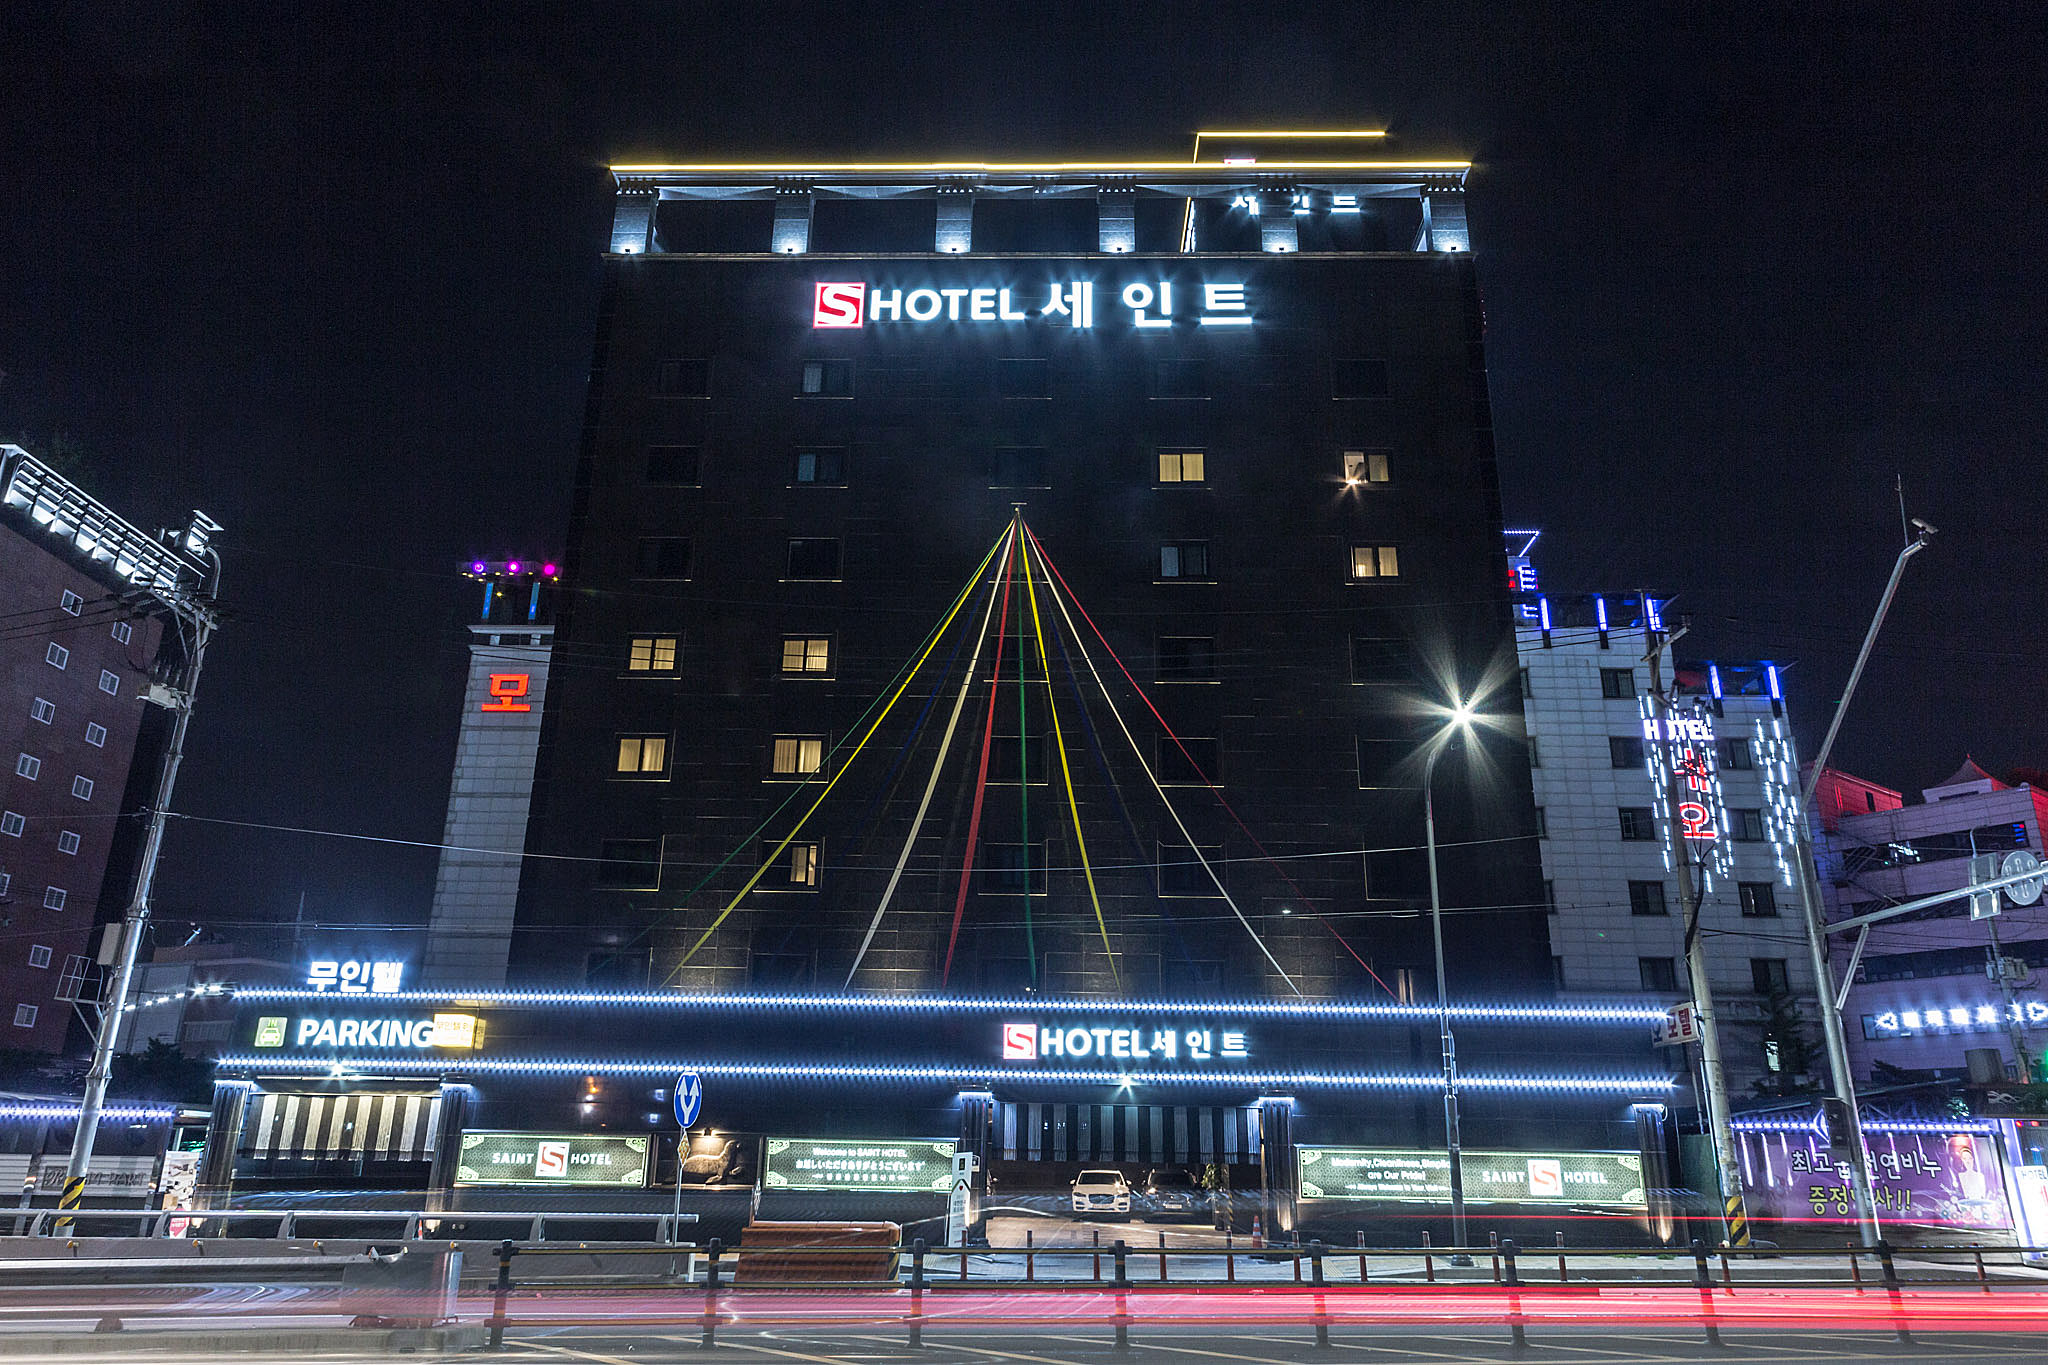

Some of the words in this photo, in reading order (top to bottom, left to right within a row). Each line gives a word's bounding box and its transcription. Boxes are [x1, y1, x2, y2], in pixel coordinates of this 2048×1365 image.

[868, 286, 1026, 322] HOTEL
[481, 673, 531, 712] 모
[306, 961, 403, 993] 무인텔
[297, 1019, 434, 1047] PARKING
[1040, 1028, 1150, 1057] HOTEL
[491, 1152, 535, 1164] SAINT
[570, 1153, 613, 1165] HOTEL
[812, 1147, 847, 1157] Welcome
[848, 1148, 856, 1157] to
[857, 1148, 880, 1157] SAINT
[881, 1149, 907, 1158] HOTEL
[1367, 1171, 1382, 1179] are
[1383, 1171, 1399, 1180] Our
[1482, 1170, 1525, 1183] SAINT
[1564, 1171, 1608, 1184] HOTEL
[1808, 1185, 1912, 1215] 증정사!!
